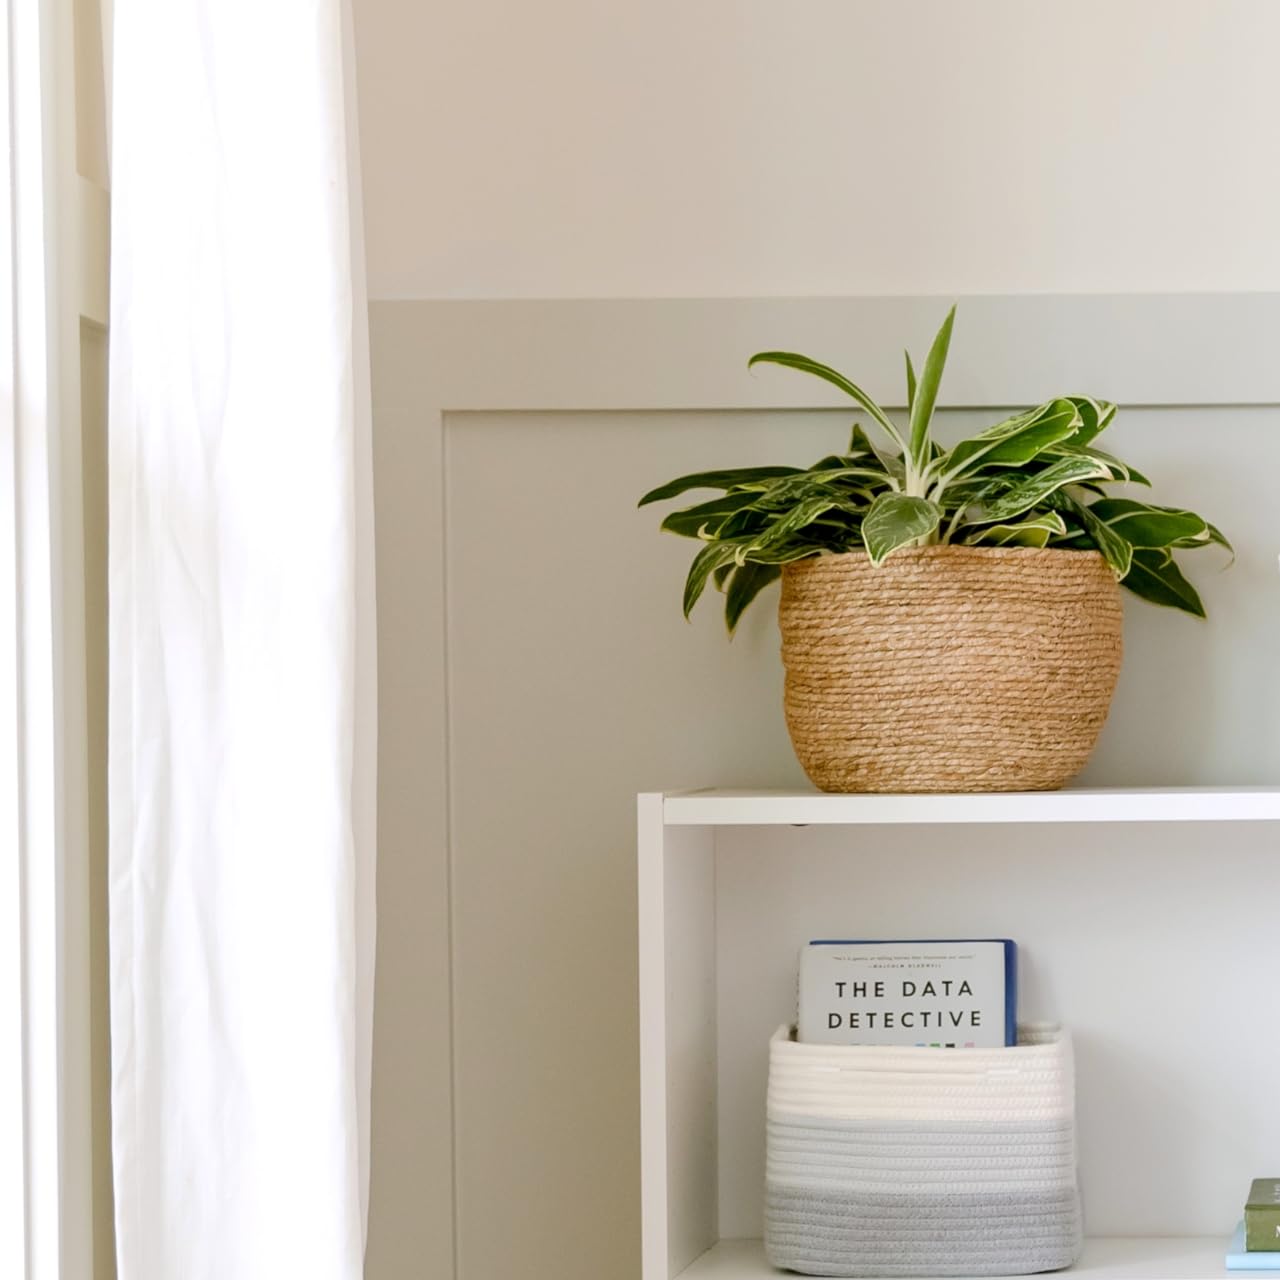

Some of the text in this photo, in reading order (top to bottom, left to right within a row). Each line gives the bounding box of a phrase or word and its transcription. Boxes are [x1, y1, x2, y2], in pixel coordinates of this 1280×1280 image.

[835, 980, 973, 998] THE DATA
[828, 1010, 981, 1029] DETECTIVE
